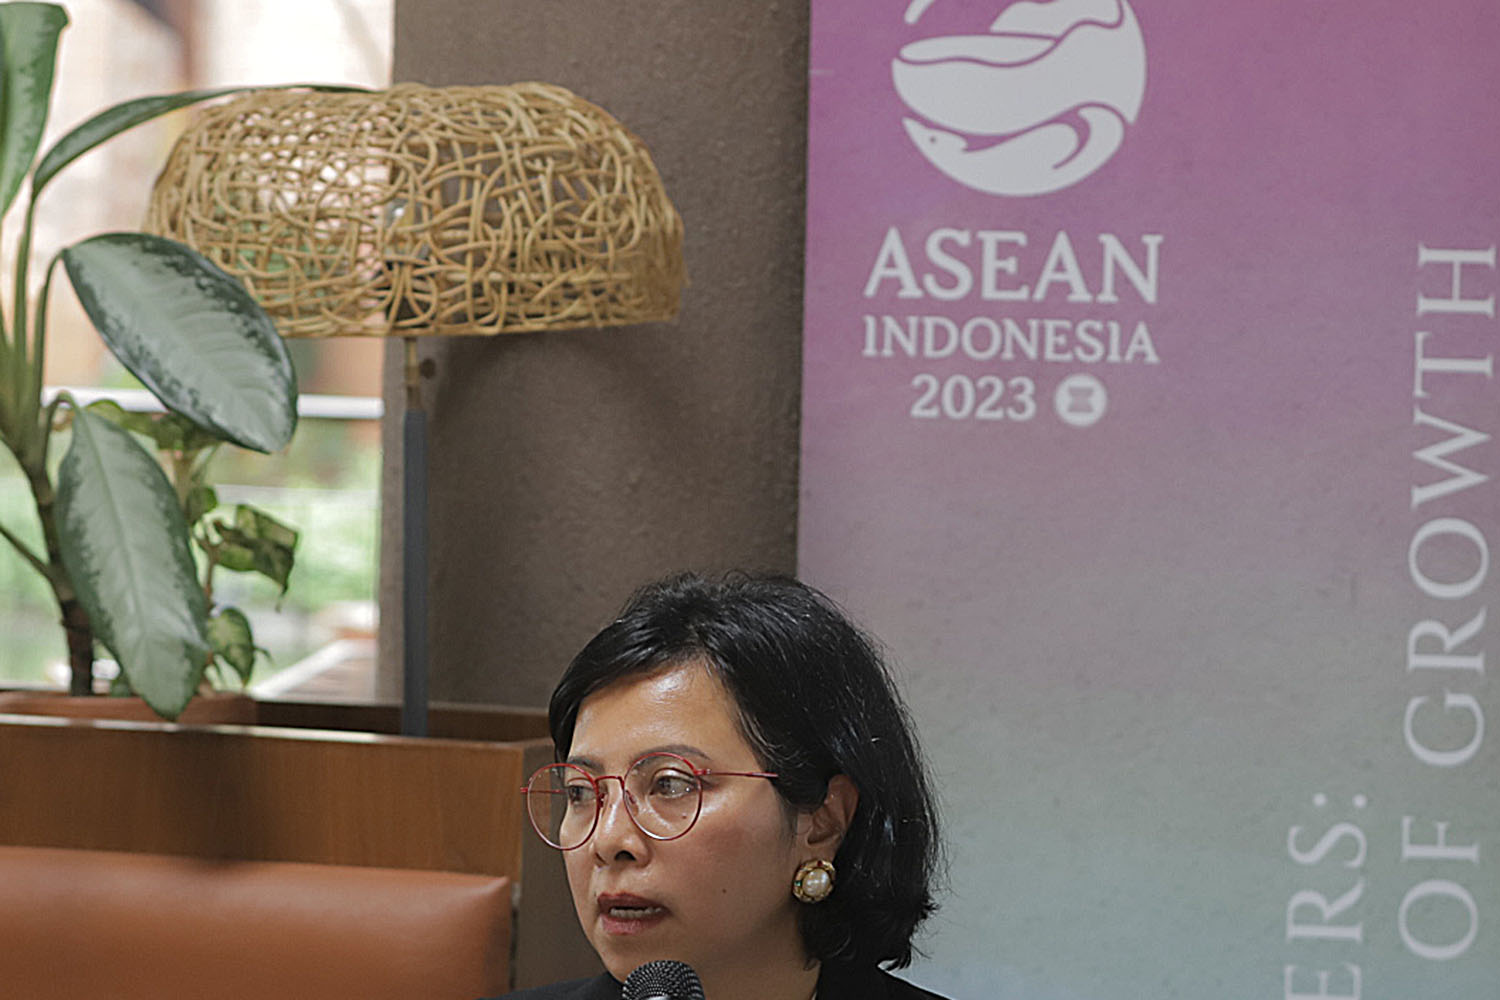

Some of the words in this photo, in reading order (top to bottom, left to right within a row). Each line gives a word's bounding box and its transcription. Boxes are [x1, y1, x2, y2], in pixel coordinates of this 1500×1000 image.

[864, 227, 1163, 303] ASEAN
[861, 315, 1160, 364] INDONESIA
[910, 374, 1036, 420] 2023
[1405, 244, 1496, 767] GROWTH
[1398, 816, 1480, 961] OF
